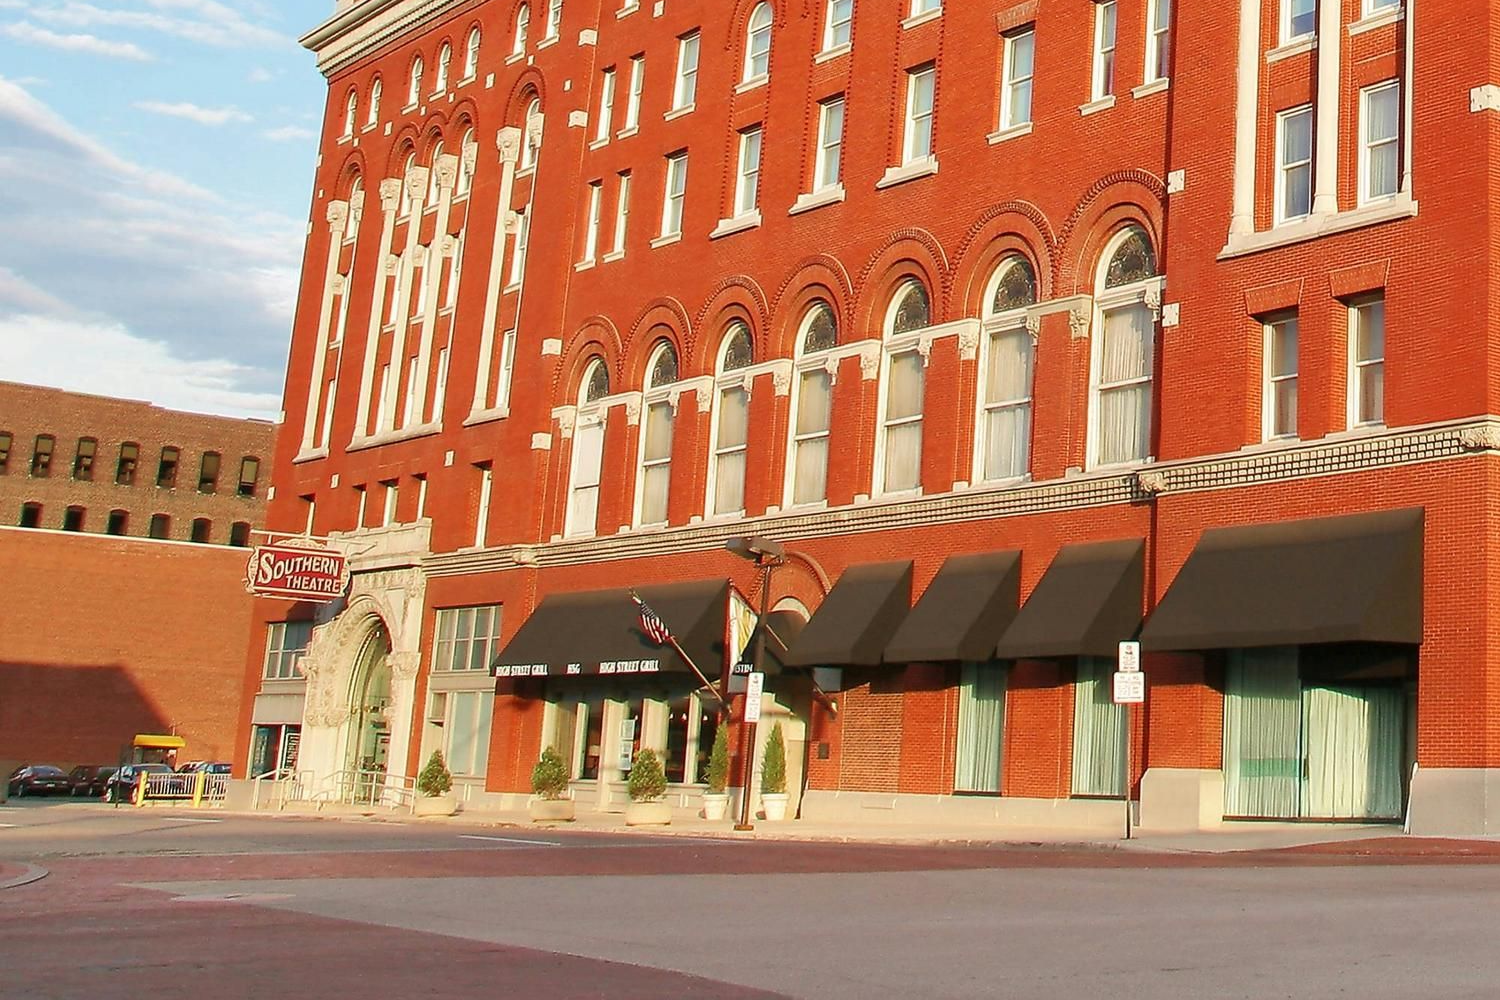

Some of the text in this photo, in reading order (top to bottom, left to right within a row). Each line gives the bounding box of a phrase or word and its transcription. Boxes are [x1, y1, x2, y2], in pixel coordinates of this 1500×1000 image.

[257, 552, 340, 584] SOUTHERN
[285, 575, 340, 593] THEATRE
[496, 664, 548, 677] HIGH STREET GRILL
[600, 660, 659, 674] HIGH STREET GRILL
